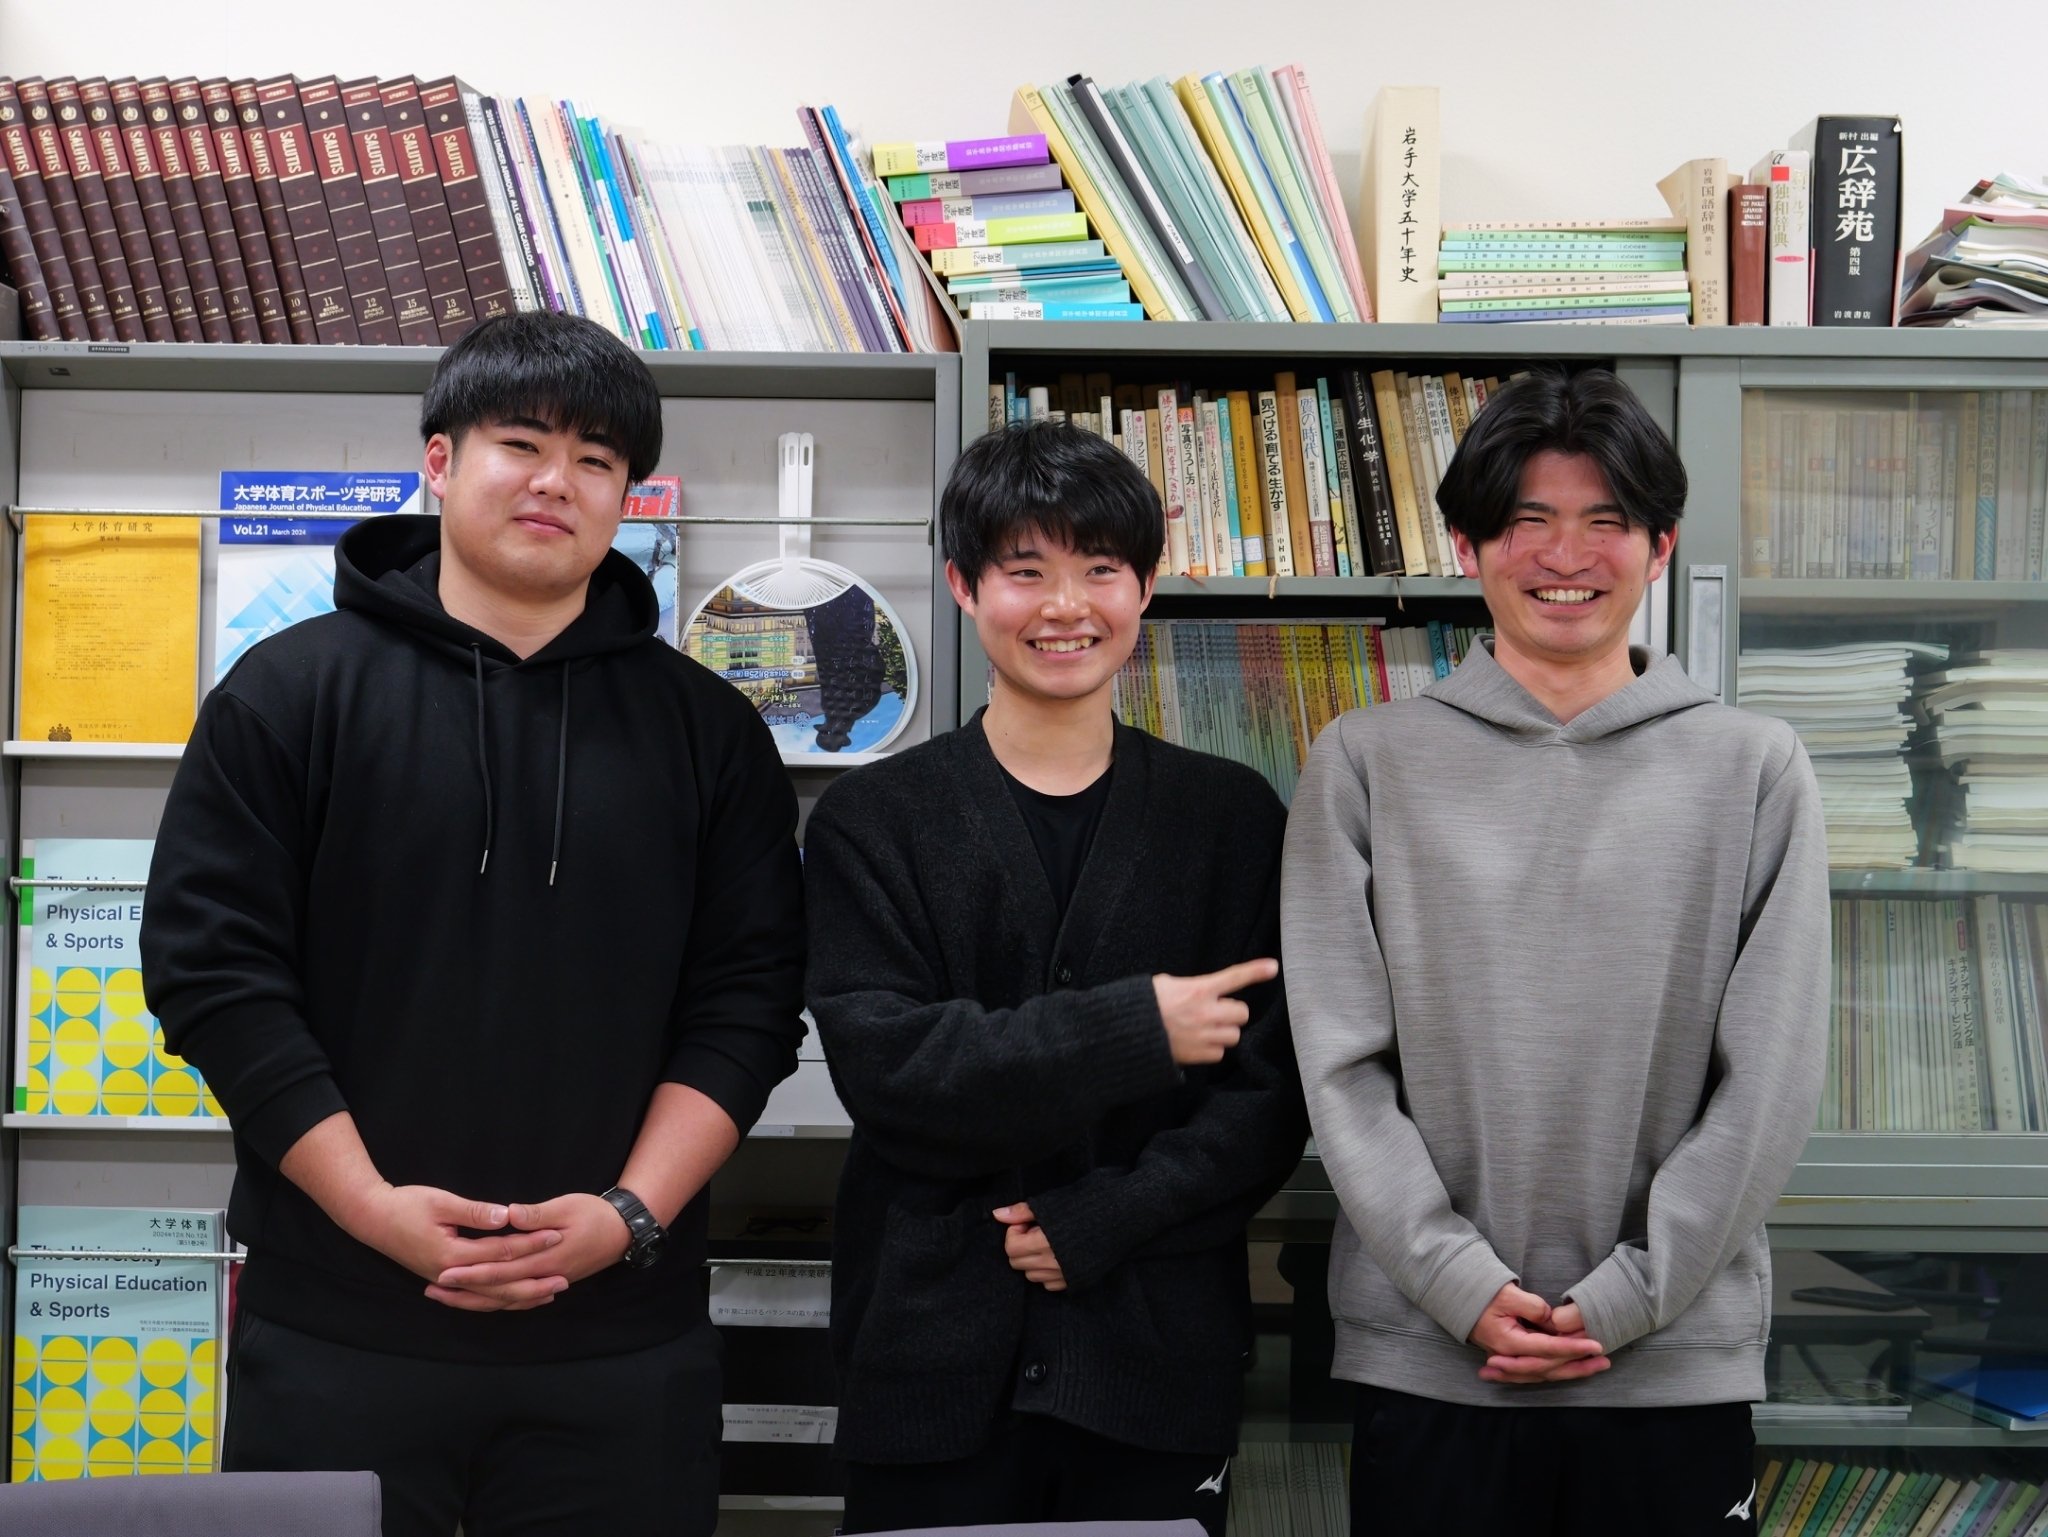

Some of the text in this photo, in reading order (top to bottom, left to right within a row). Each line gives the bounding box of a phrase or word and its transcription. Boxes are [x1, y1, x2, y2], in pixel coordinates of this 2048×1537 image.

[1839, 132, 1879, 142] 新村 出編
[7, 129, 30, 172] SALUTIS
[39, 128, 60, 172] SALUTIS
[68, 129, 90, 173] SALUTIS
[98, 130, 120, 173] SALUTIS
[129, 130, 151, 173] SALUTIS
[160, 131, 180, 173] SALUTIS
[189, 130, 210, 172] SALUTIS
[220, 132, 241, 174] SALUTIS
[250, 132, 271, 175] SALUTIS
[280, 131, 302, 174] SALUTIS
[323, 132, 344, 175] SALUTIS
[364, 133, 385, 175] SALUTIS
[403, 133, 424, 176] SALUTIS
[444, 135, 465, 177] SALUTIS
[486, 108, 534, 267] 2015 UNDER ARMOUR ALL GEAR CATALOG
[1834, 145, 1878, 243] 広辞苑
[1398, 126, 1419, 283] 岩手大学五十年史
[1702, 168, 1714, 234] 岩波国語辞典
[1774, 184, 1789, 248] 独和辞典
[1848, 247, 1861, 276] 第四版
[28, 290, 33, 300] 1
[58, 293, 65, 302] 2
[89, 293, 96, 302] 3
[116, 294, 124, 304] 4
[146, 295, 152, 304] 5
[176, 295, 182, 304] 6
[204, 296, 210, 306] 7
[233, 296, 240, 304] 8
[263, 298, 270, 307] 9
[290, 298, 300, 307] 10
[323, 296, 334, 306] 11
[366, 297, 377, 308] 12
[406, 298, 417, 308] 15
[446, 298, 457, 308] 13
[488, 300, 499, 310] 14
[1833, 310, 1872, 320] 岩波書店
[1300, 398, 1320, 459] 質の時代
[1357, 417, 1380, 462] 生化学
[1182, 424, 1195, 486] 写真のうつし方
[1262, 398, 1284, 512] 見つける 育てる 生かす
[234, 485, 401, 502] 大学体育スポーツ学研究
[306, 504, 335, 512] Physical
[336, 504, 372, 512] Education
[70, 521, 154, 532] 大学体育研究
[234, 524, 268, 535] Vol.21
[47, 904, 122, 923] Physical
[46, 933, 124, 952] & Sports
[150, 1217, 208, 1231] 大学体育
[745, 1268, 764, 1277] 平成
[765, 1268, 776, 1277] 22
[30, 1273, 208, 1292] Physical Education
[30, 1302, 110, 1321] & Sports
